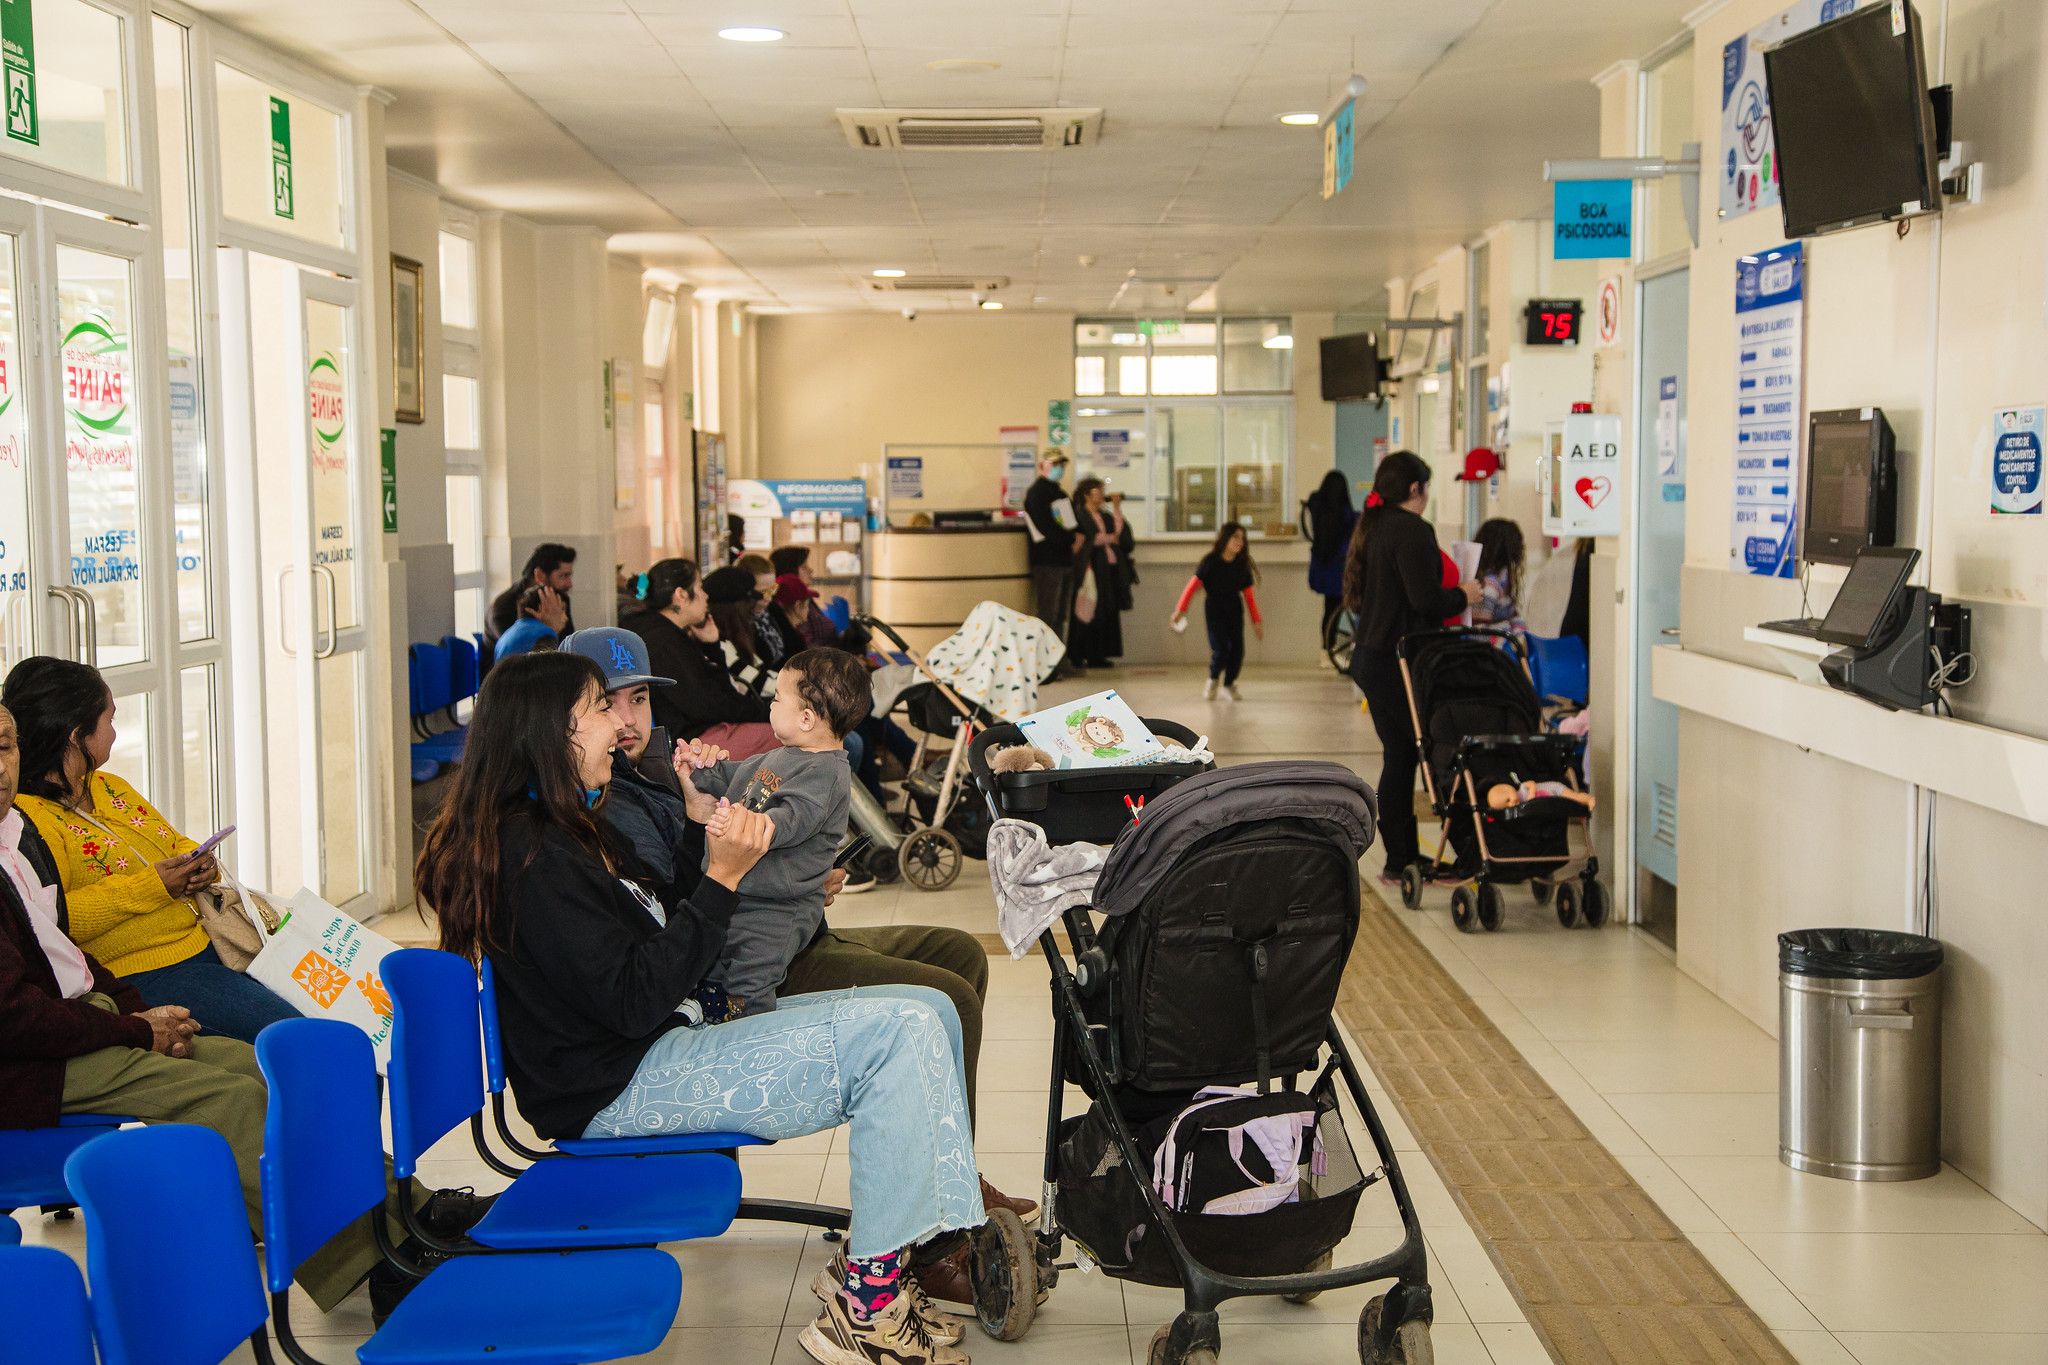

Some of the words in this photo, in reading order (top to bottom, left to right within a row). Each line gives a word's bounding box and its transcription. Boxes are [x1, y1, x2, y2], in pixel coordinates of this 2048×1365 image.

[3, 39, 17, 52] Salida
[1580, 202, 1608, 219] BOX
[1557, 221, 1629, 239] PSICOSOCIAL
[1540, 312, 1573, 339] 75
[1571, 443, 1617, 458] AED
[2000, 449, 2036, 460] MEDICAMENTOS
[2006, 475, 2027, 485] CONTROL
[777, 484, 864, 495] INFORMACIONES
[607, 637, 635, 670] LA
[322, 917, 342, 940] Steps
[338, 921, 358, 951] County
